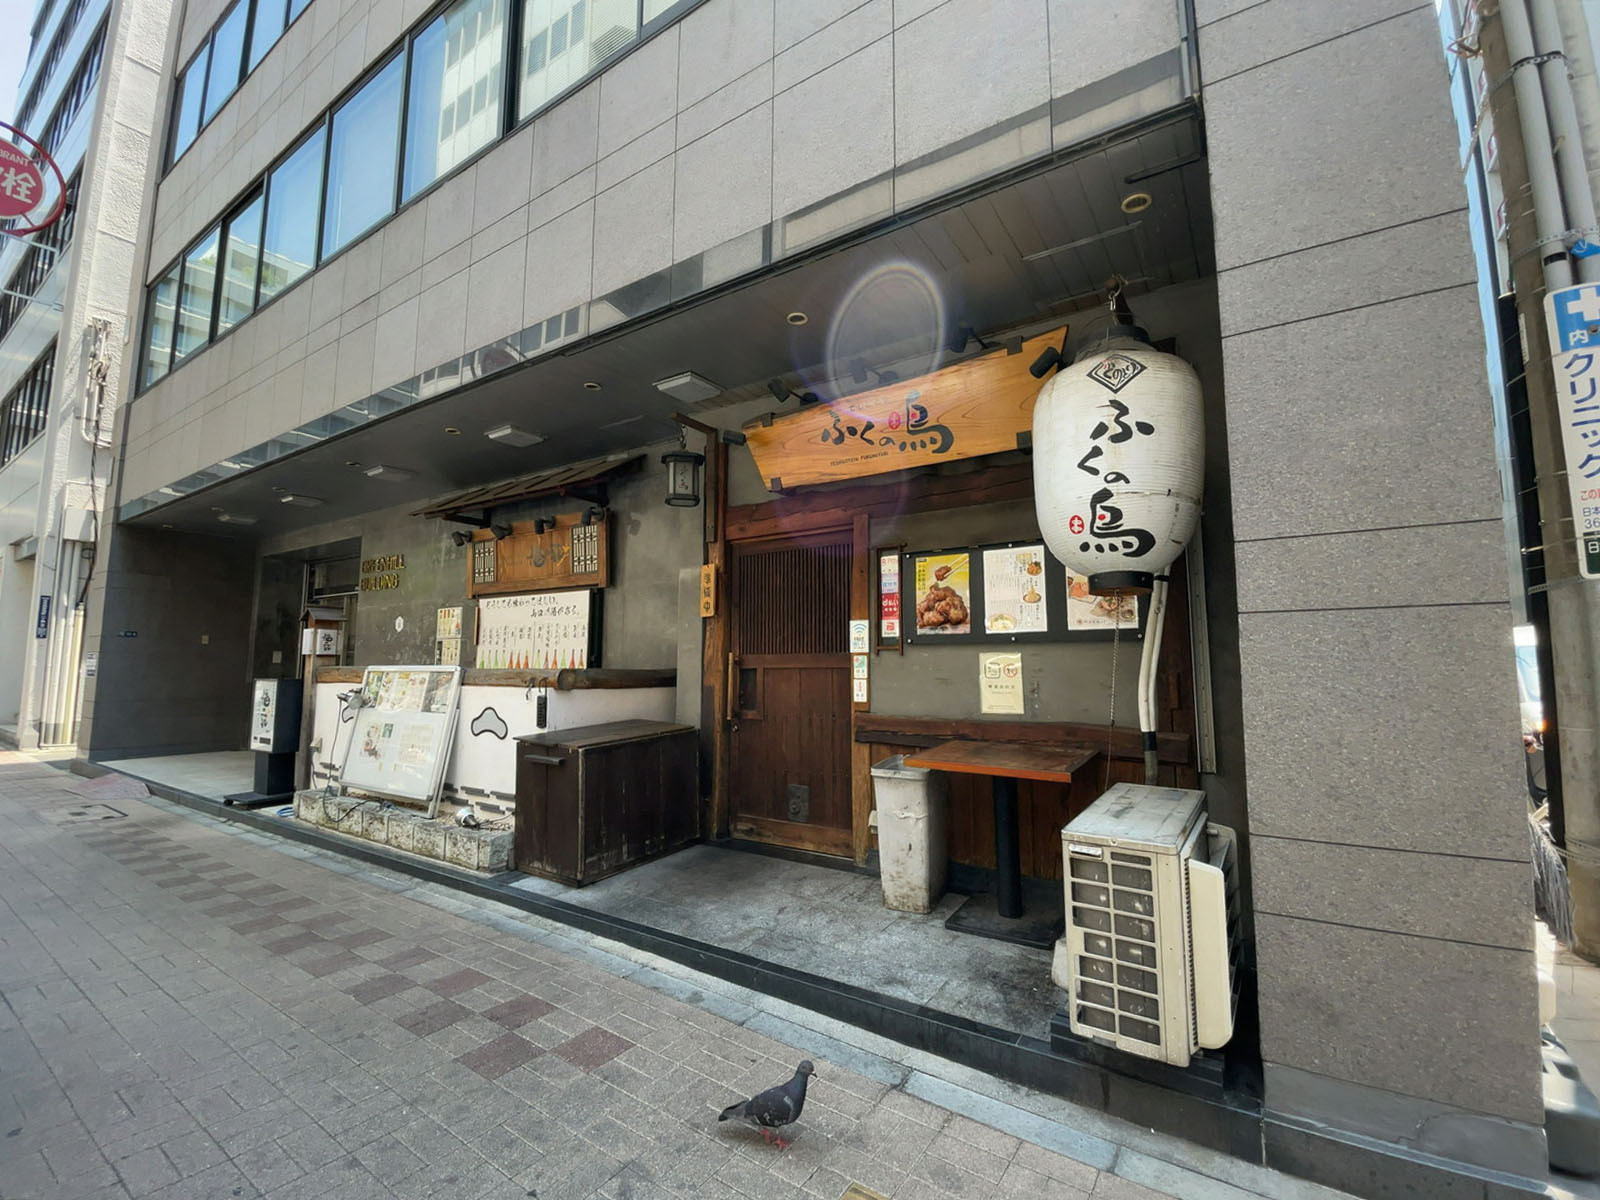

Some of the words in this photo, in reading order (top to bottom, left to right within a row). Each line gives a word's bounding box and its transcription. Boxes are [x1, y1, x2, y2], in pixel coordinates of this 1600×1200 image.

[0, 166, 37, 203] 栓
[1564, 353, 1600, 479] クリニック
